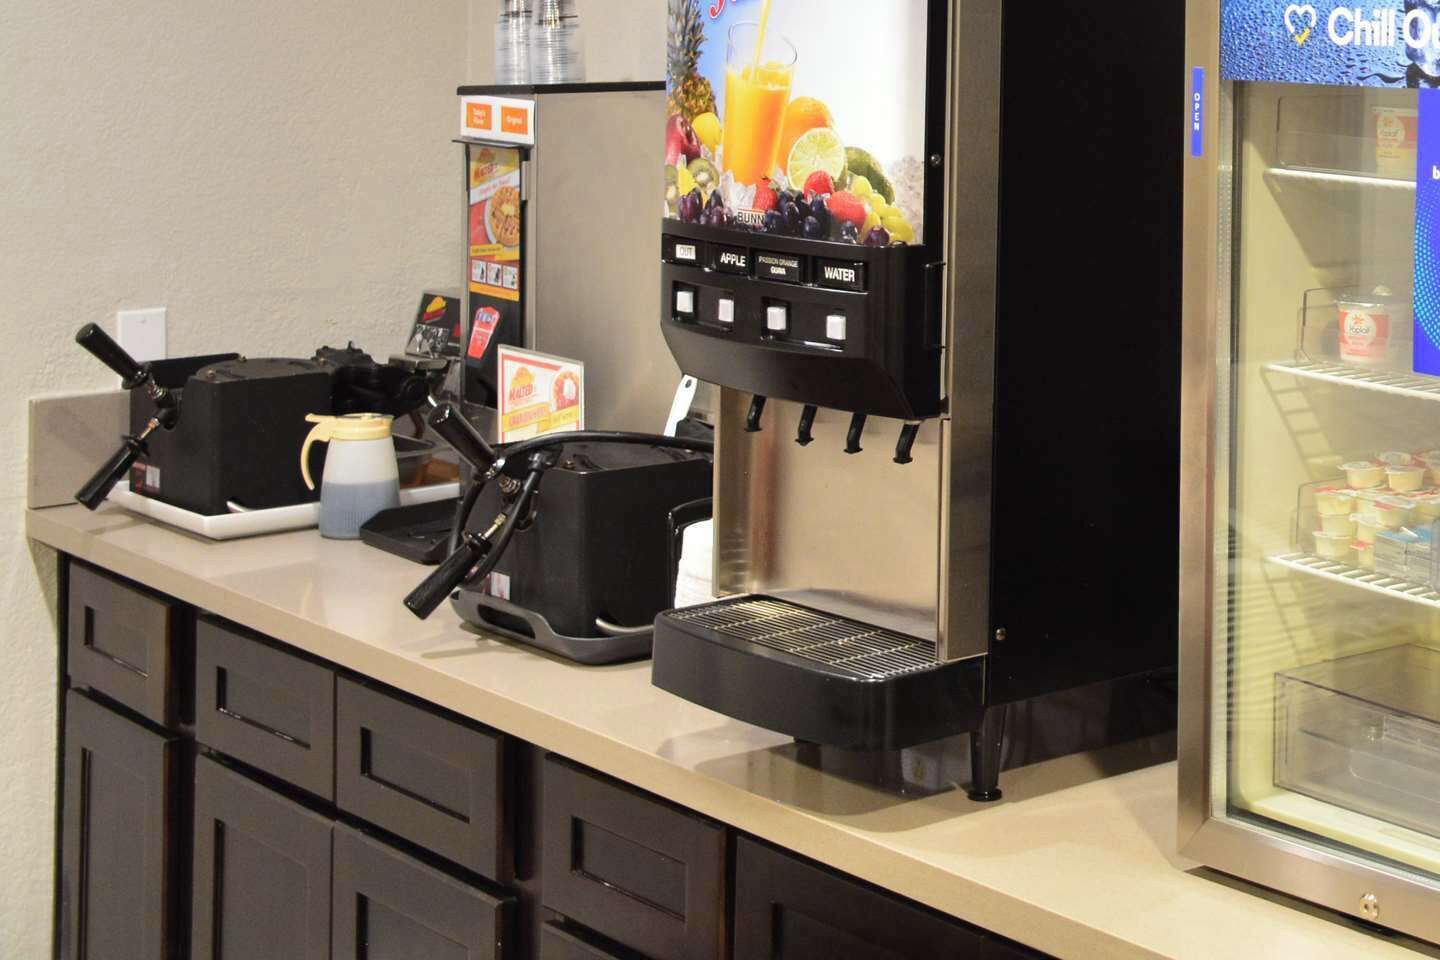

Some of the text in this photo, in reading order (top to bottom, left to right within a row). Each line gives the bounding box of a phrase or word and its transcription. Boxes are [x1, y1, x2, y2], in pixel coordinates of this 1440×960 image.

[1328, 6, 1396, 47] Chill
[1193, 92, 1201, 131] OPEN
[737, 211, 765, 225] BUNN
[720, 252, 746, 268] APPLE
[779, 257, 799, 269] ORANGE
[824, 266, 856, 283] WATER
